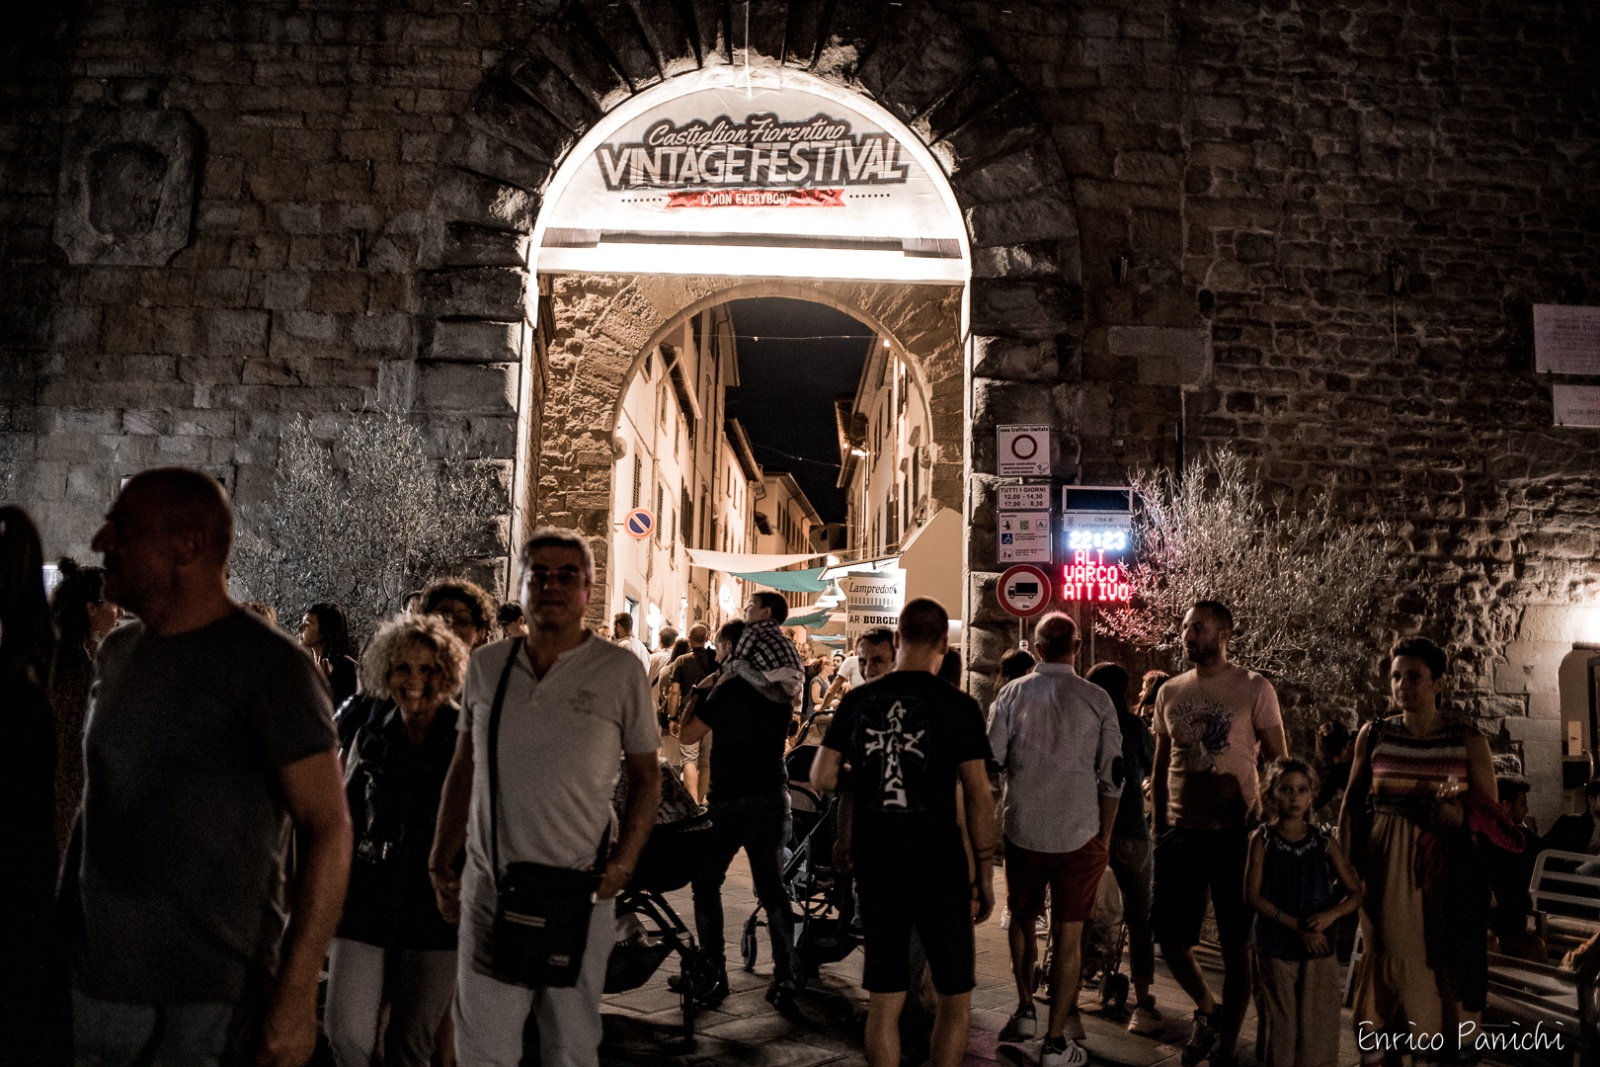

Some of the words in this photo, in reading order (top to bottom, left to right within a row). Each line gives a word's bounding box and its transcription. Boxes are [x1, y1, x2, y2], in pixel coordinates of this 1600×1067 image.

[649, 120, 748, 149] Castiglion
[749, 117, 846, 143] Fiorentino
[601, 143, 745, 187] VINTAGE
[749, 137, 905, 184] FESTIVAL
[701, 193, 733, 206] C'MON
[735, 191, 791, 206] EVERYBODY
[1069, 531, 1126, 550] 22:23
[1075, 548, 1105, 566] ALT
[1063, 565, 1118, 583] VARCO
[1063, 583, 1129, 601] ATTIVO
